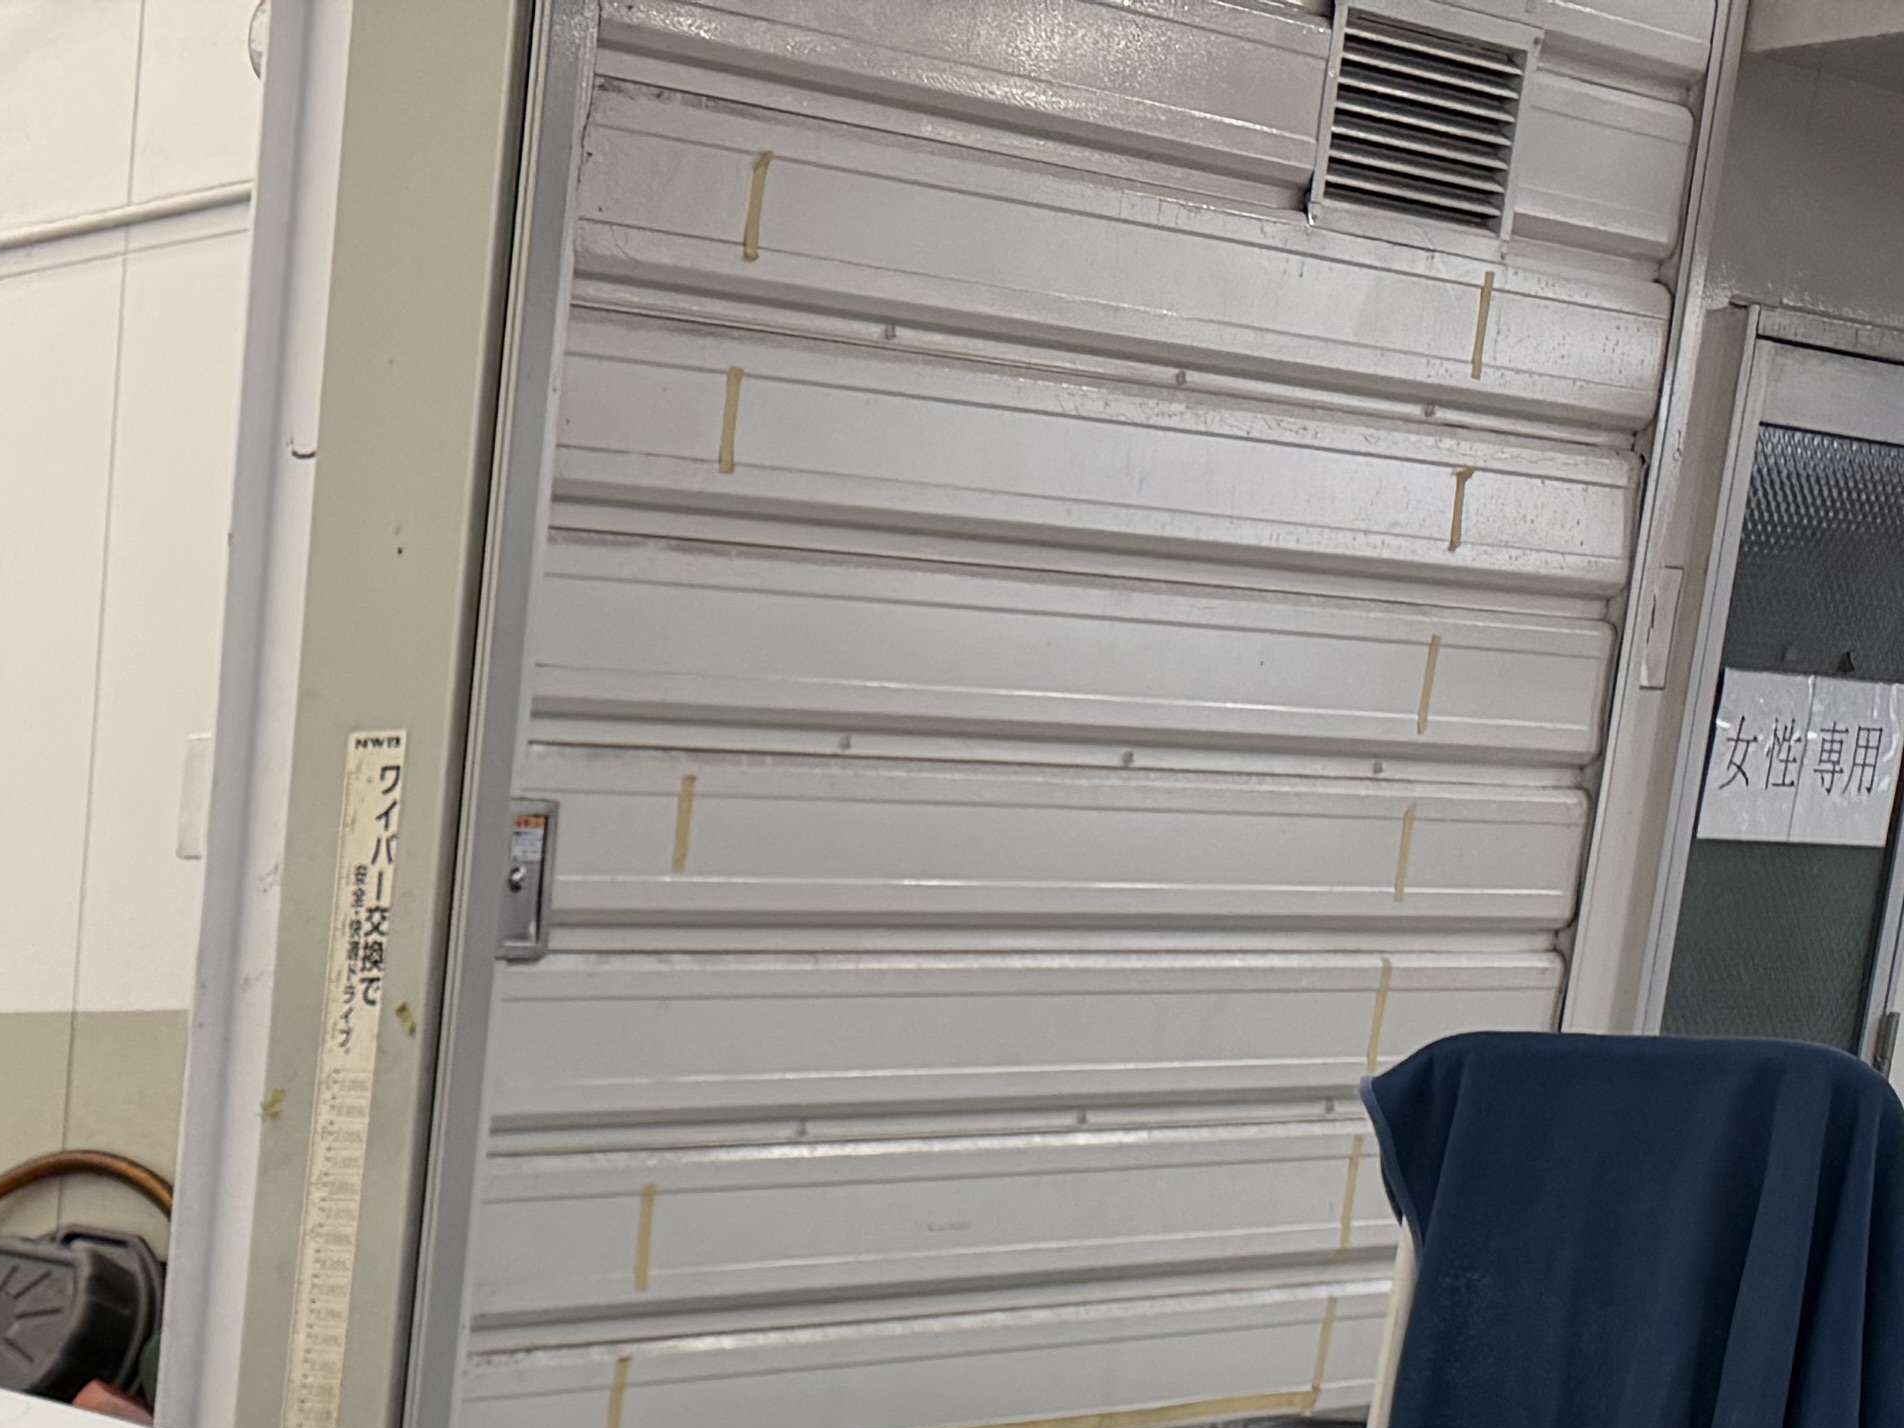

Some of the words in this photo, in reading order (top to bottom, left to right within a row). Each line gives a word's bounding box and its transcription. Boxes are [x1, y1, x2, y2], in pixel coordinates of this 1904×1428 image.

[1718, 714, 1884, 797] 女性専用
[359, 765, 401, 1007] ワイパー交換で
